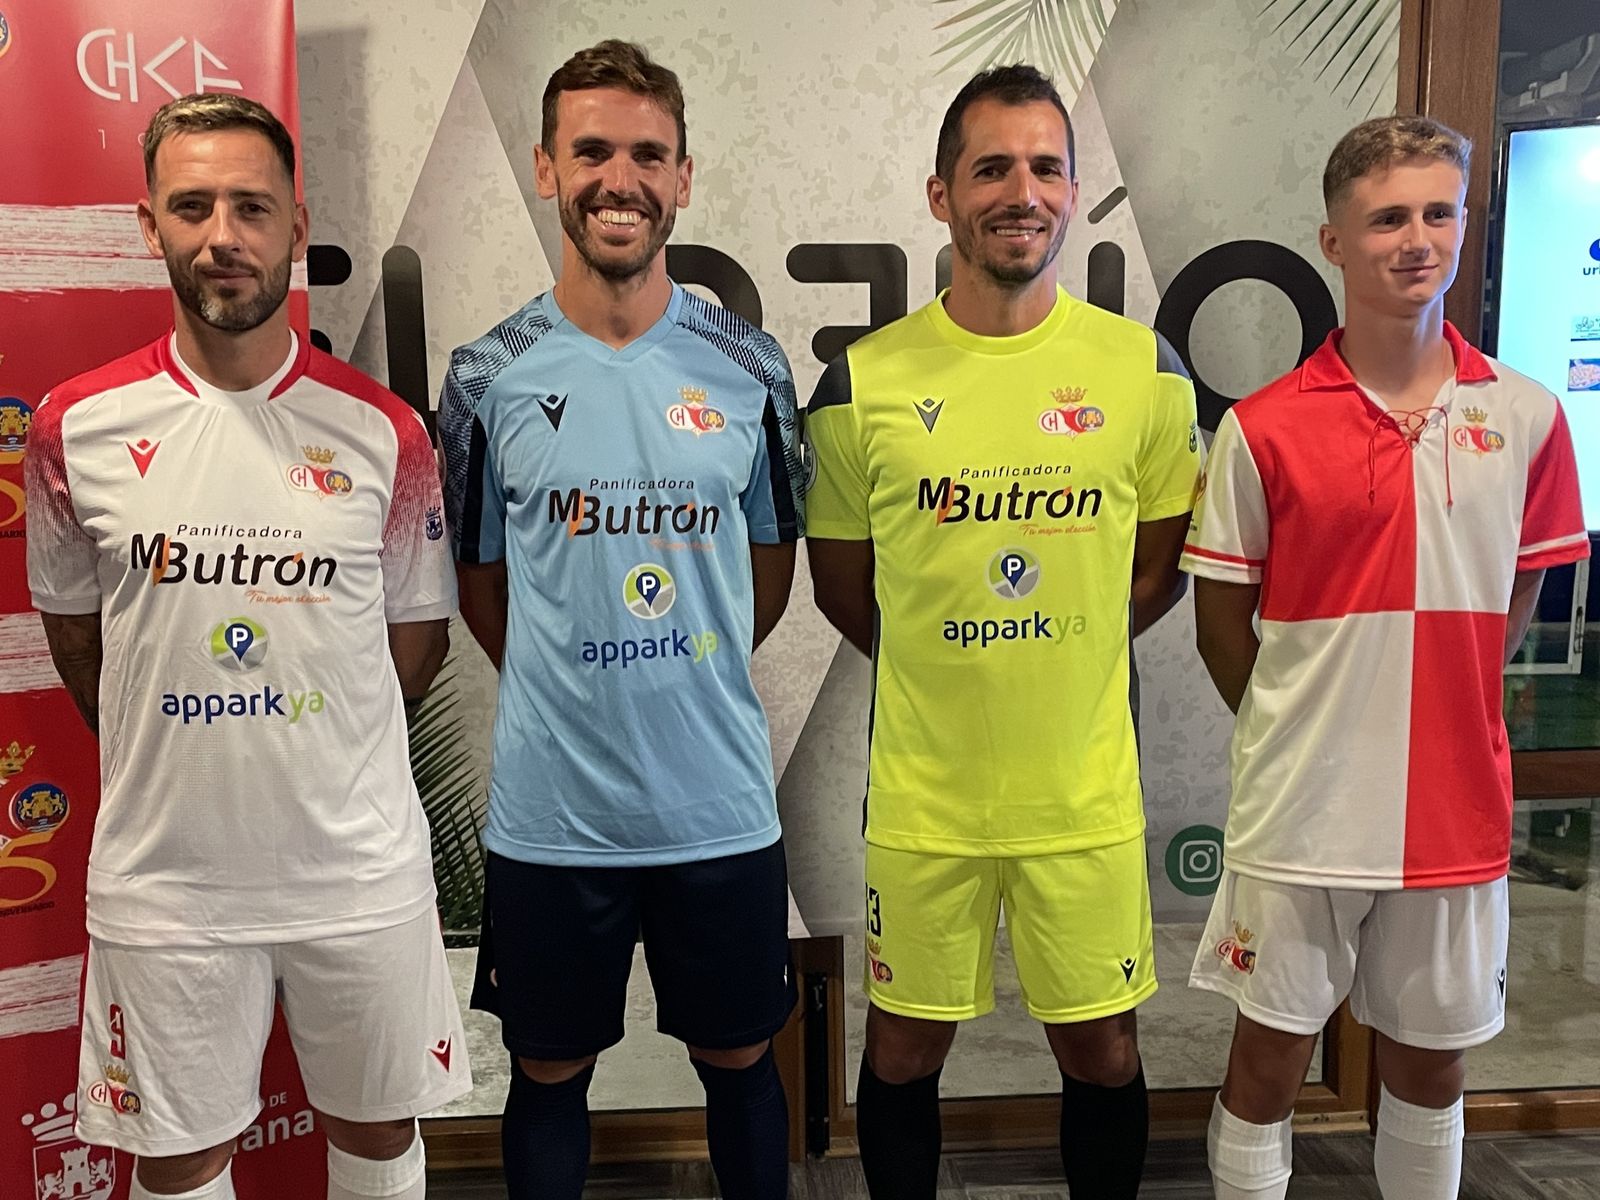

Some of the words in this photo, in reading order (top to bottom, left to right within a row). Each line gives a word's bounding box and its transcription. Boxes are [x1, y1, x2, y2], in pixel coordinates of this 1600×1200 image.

[961, 464, 1072, 479] Panificadora
[590, 478, 695, 491] Panificadora
[177, 524, 303, 540] Panificadora
[943, 611, 1086, 647] apparkya
[582, 629, 718, 669] apparkya
[162, 686, 325, 724] apparkya
[269, 1092, 287, 1108] DE
